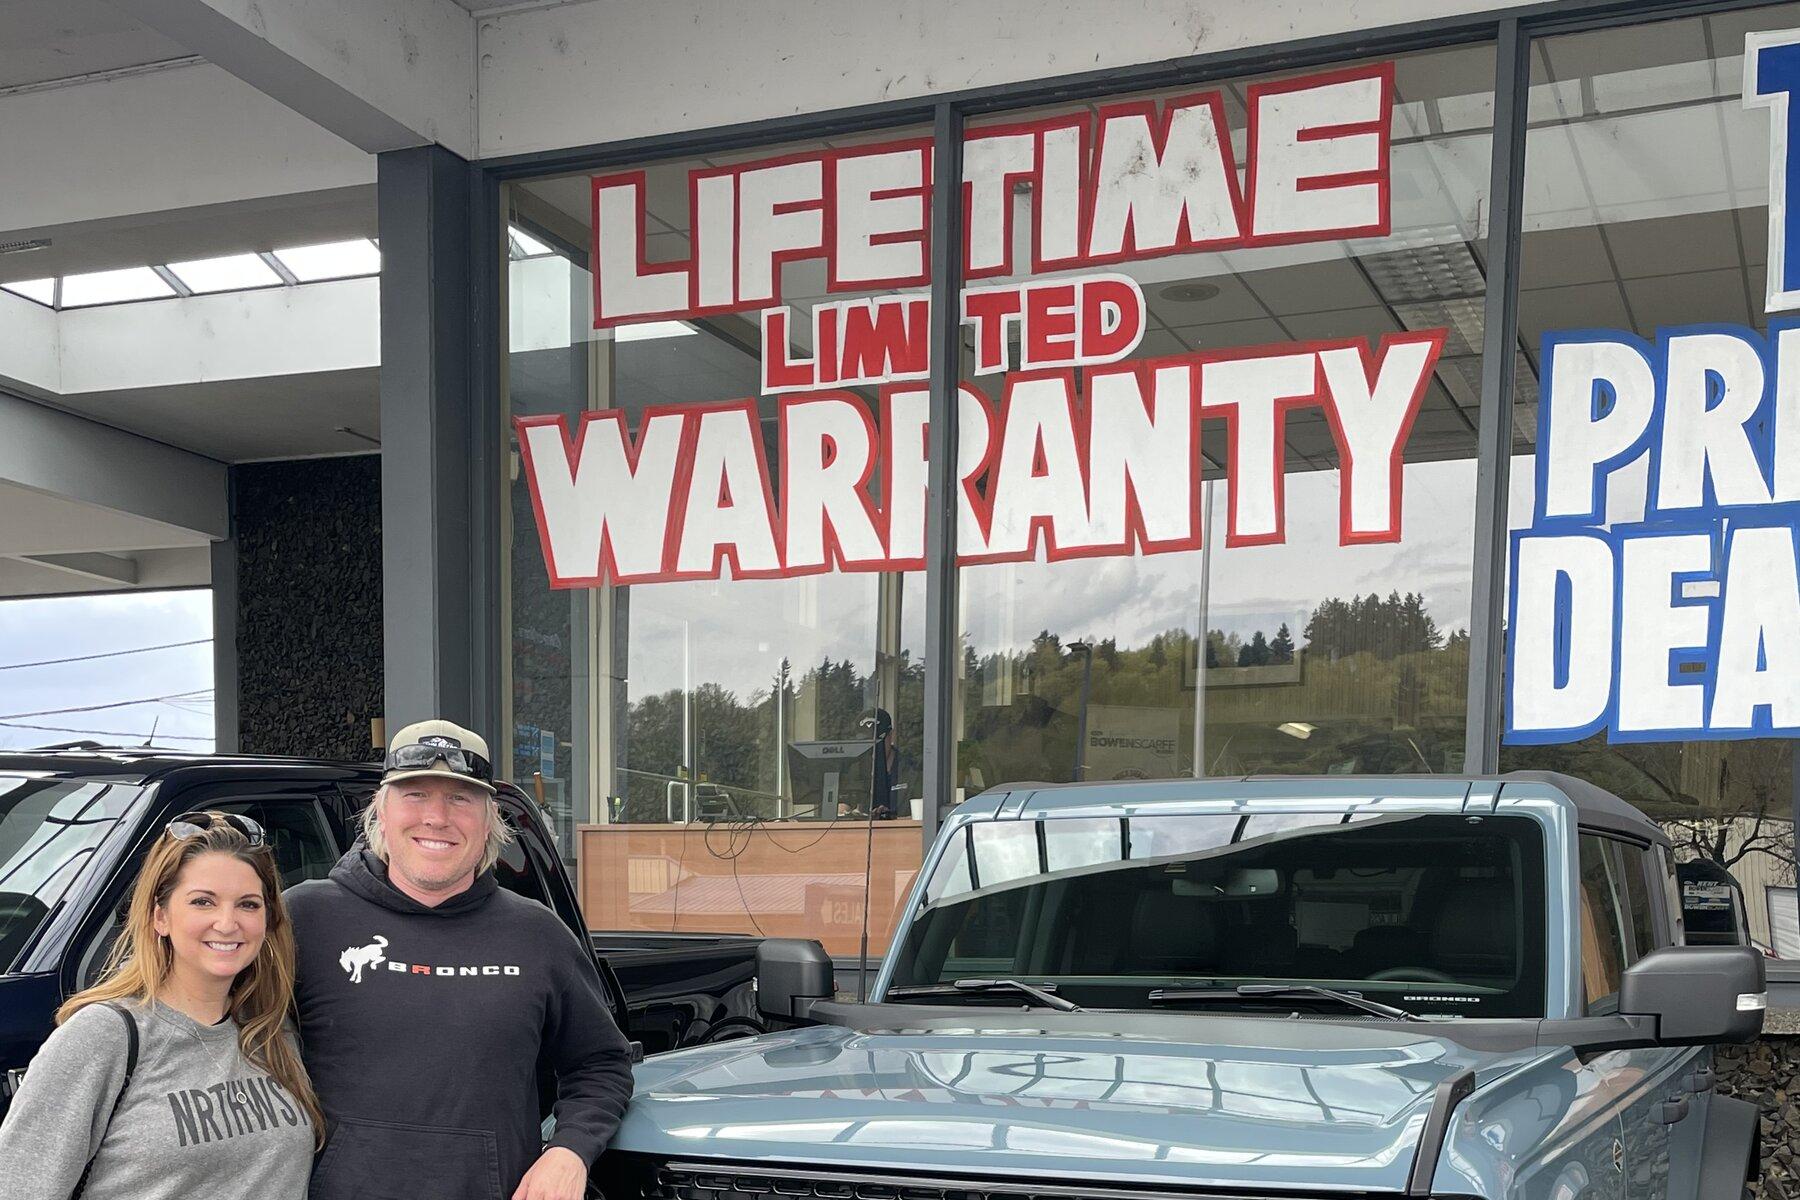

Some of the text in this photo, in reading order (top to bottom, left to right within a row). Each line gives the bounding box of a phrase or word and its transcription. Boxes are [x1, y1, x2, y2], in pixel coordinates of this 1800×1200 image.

[593, 63, 1394, 328] LIFETIME
[762, 274, 1146, 394] LIMITED
[515, 328, 1448, 589] WARRANTY
[822, 747, 845, 755] DELL
[388, 961, 520, 976] BRONCO
